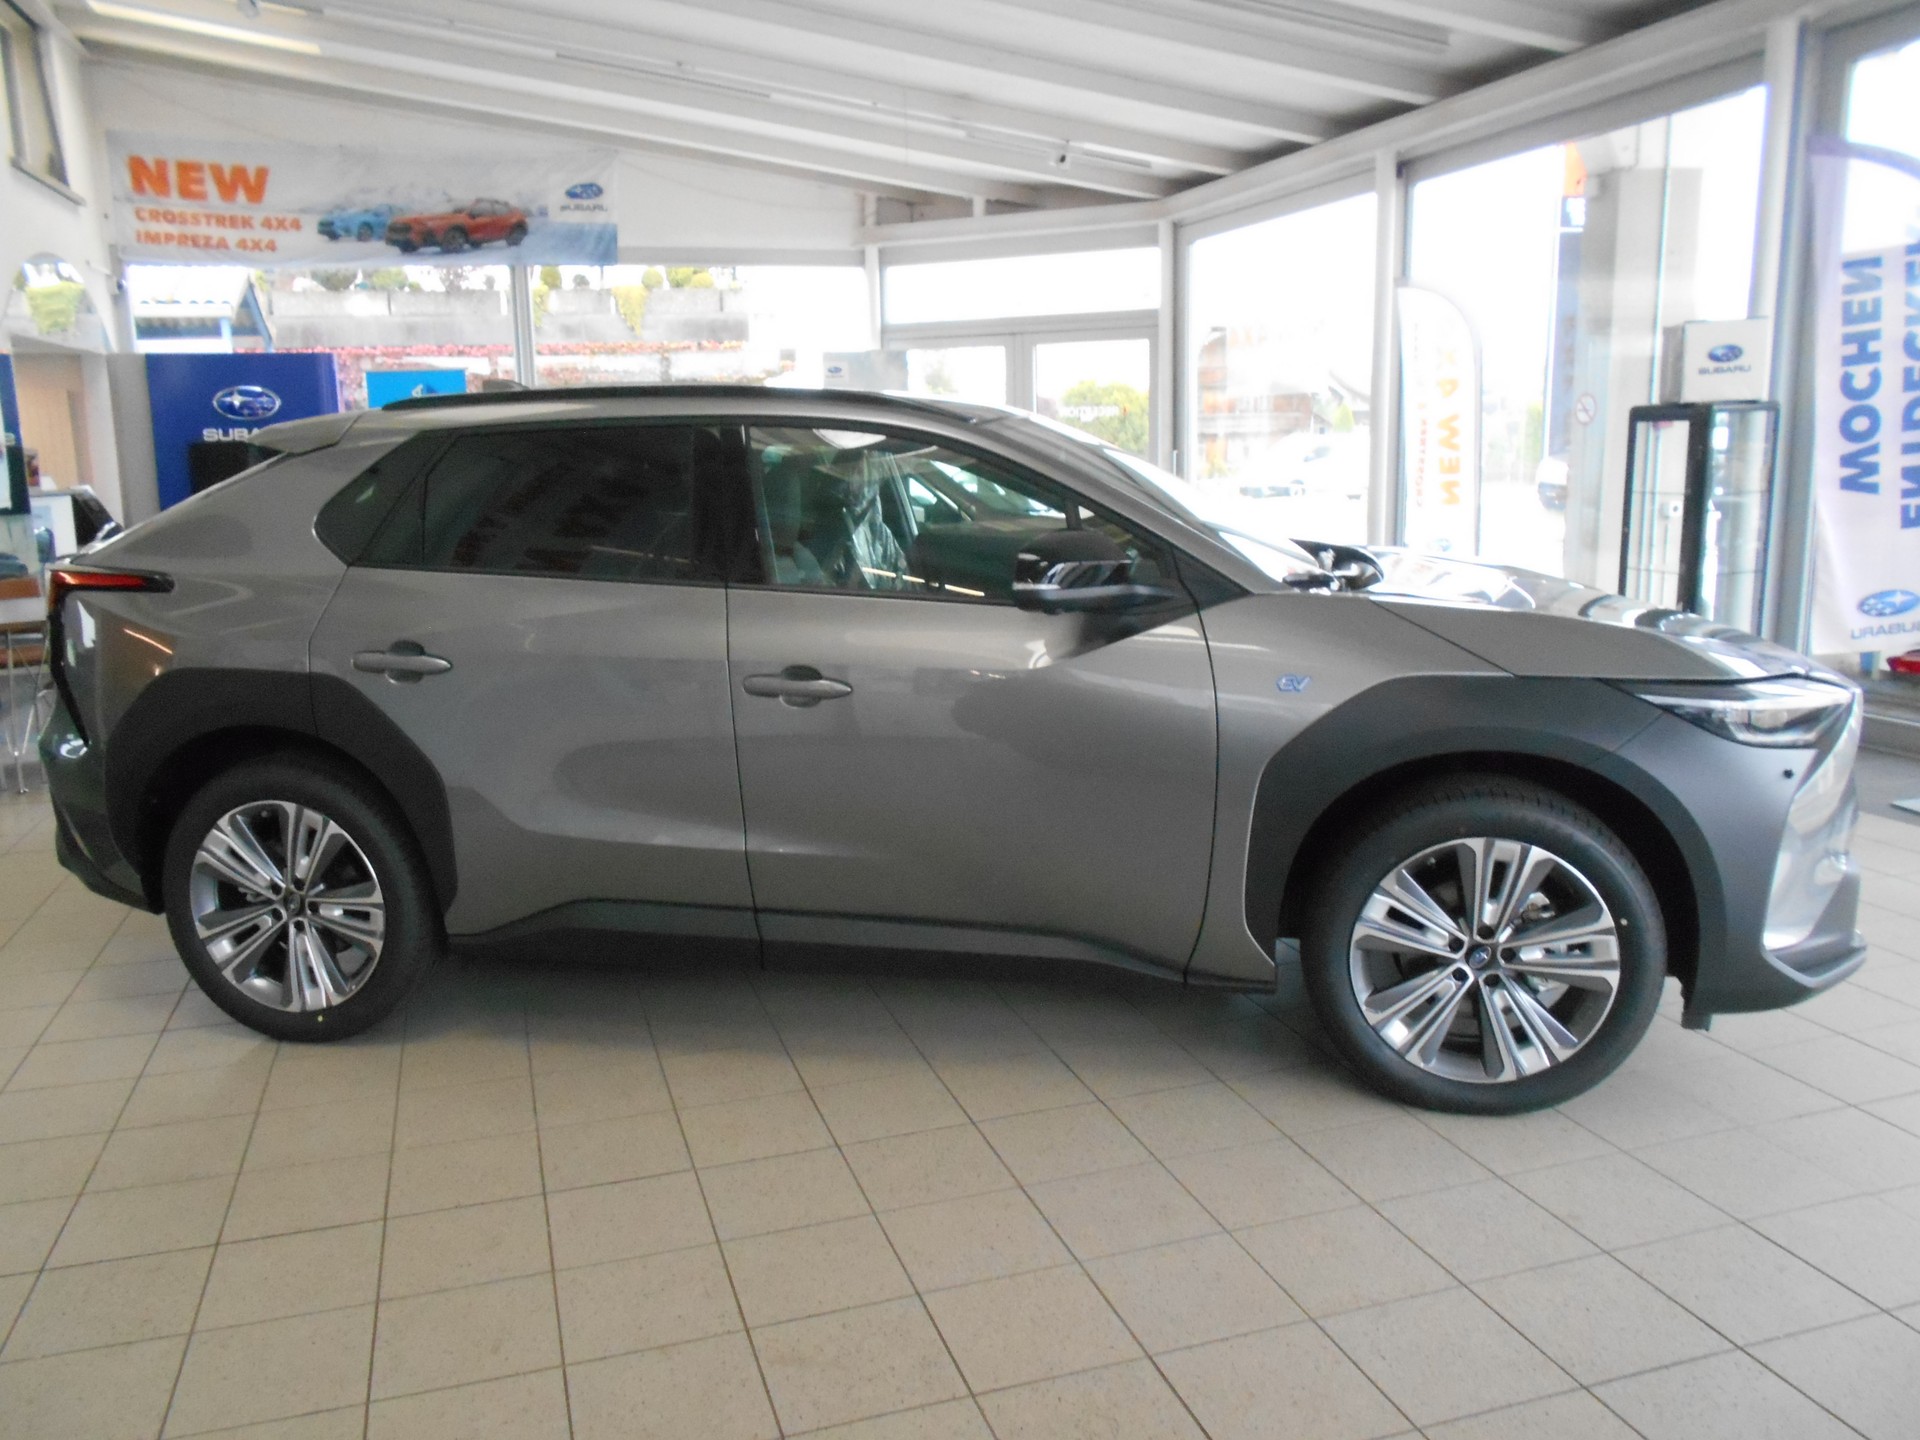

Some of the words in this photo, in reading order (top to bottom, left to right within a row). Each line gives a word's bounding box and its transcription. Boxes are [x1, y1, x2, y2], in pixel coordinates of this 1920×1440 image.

[128, 154, 269, 204] NEW
[134, 206, 255, 231] CROSSTREK
[260, 215, 303, 232] 4X4
[136, 229, 230, 251] IMPREZA
[235, 237, 278, 253] 4X4
[1698, 365, 1752, 375] SUBARU
